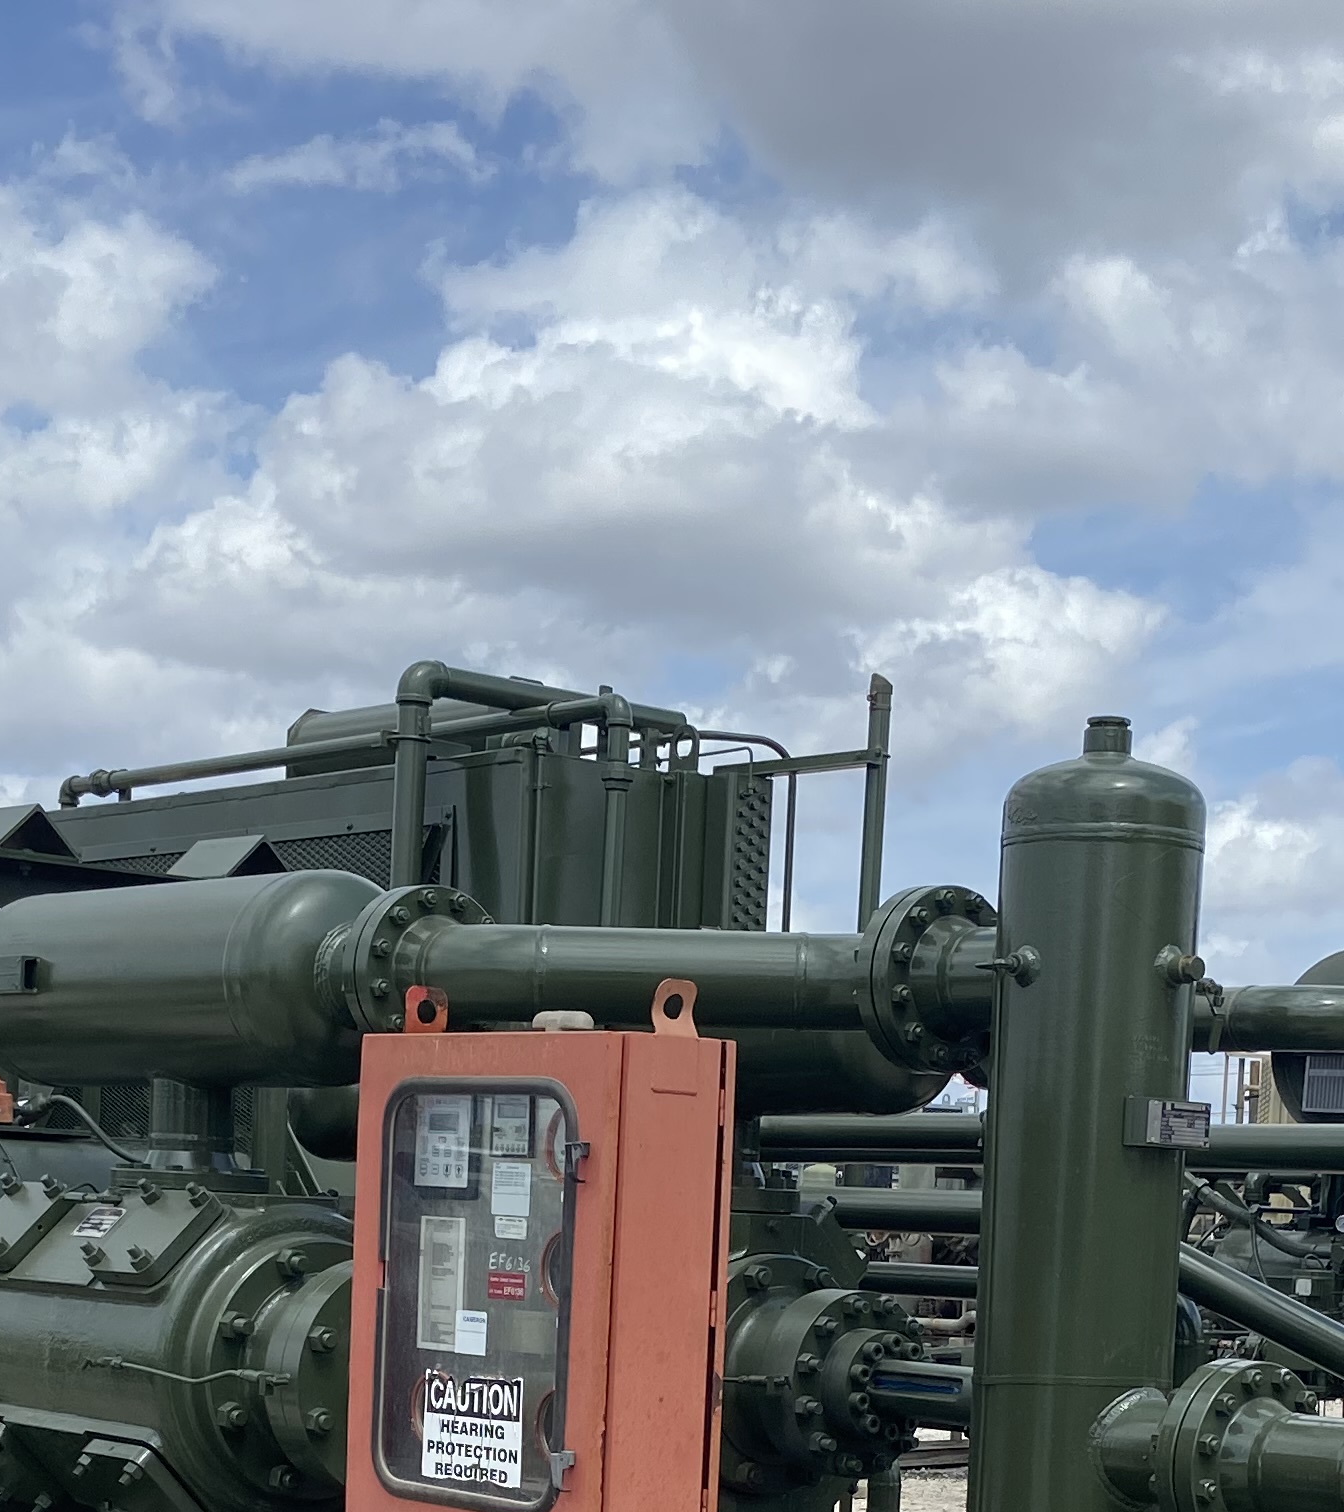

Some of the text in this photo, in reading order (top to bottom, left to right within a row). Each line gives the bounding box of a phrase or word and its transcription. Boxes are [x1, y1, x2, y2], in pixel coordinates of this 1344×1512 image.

[488, 1251, 531, 1273] EF6136
[430, 1378, 518, 1417] CAUTION
[441, 1419, 505, 1440] HEARING
[427, 1440, 518, 1464] PROTECTION
[434, 1462, 508, 1483] REQUIRED
